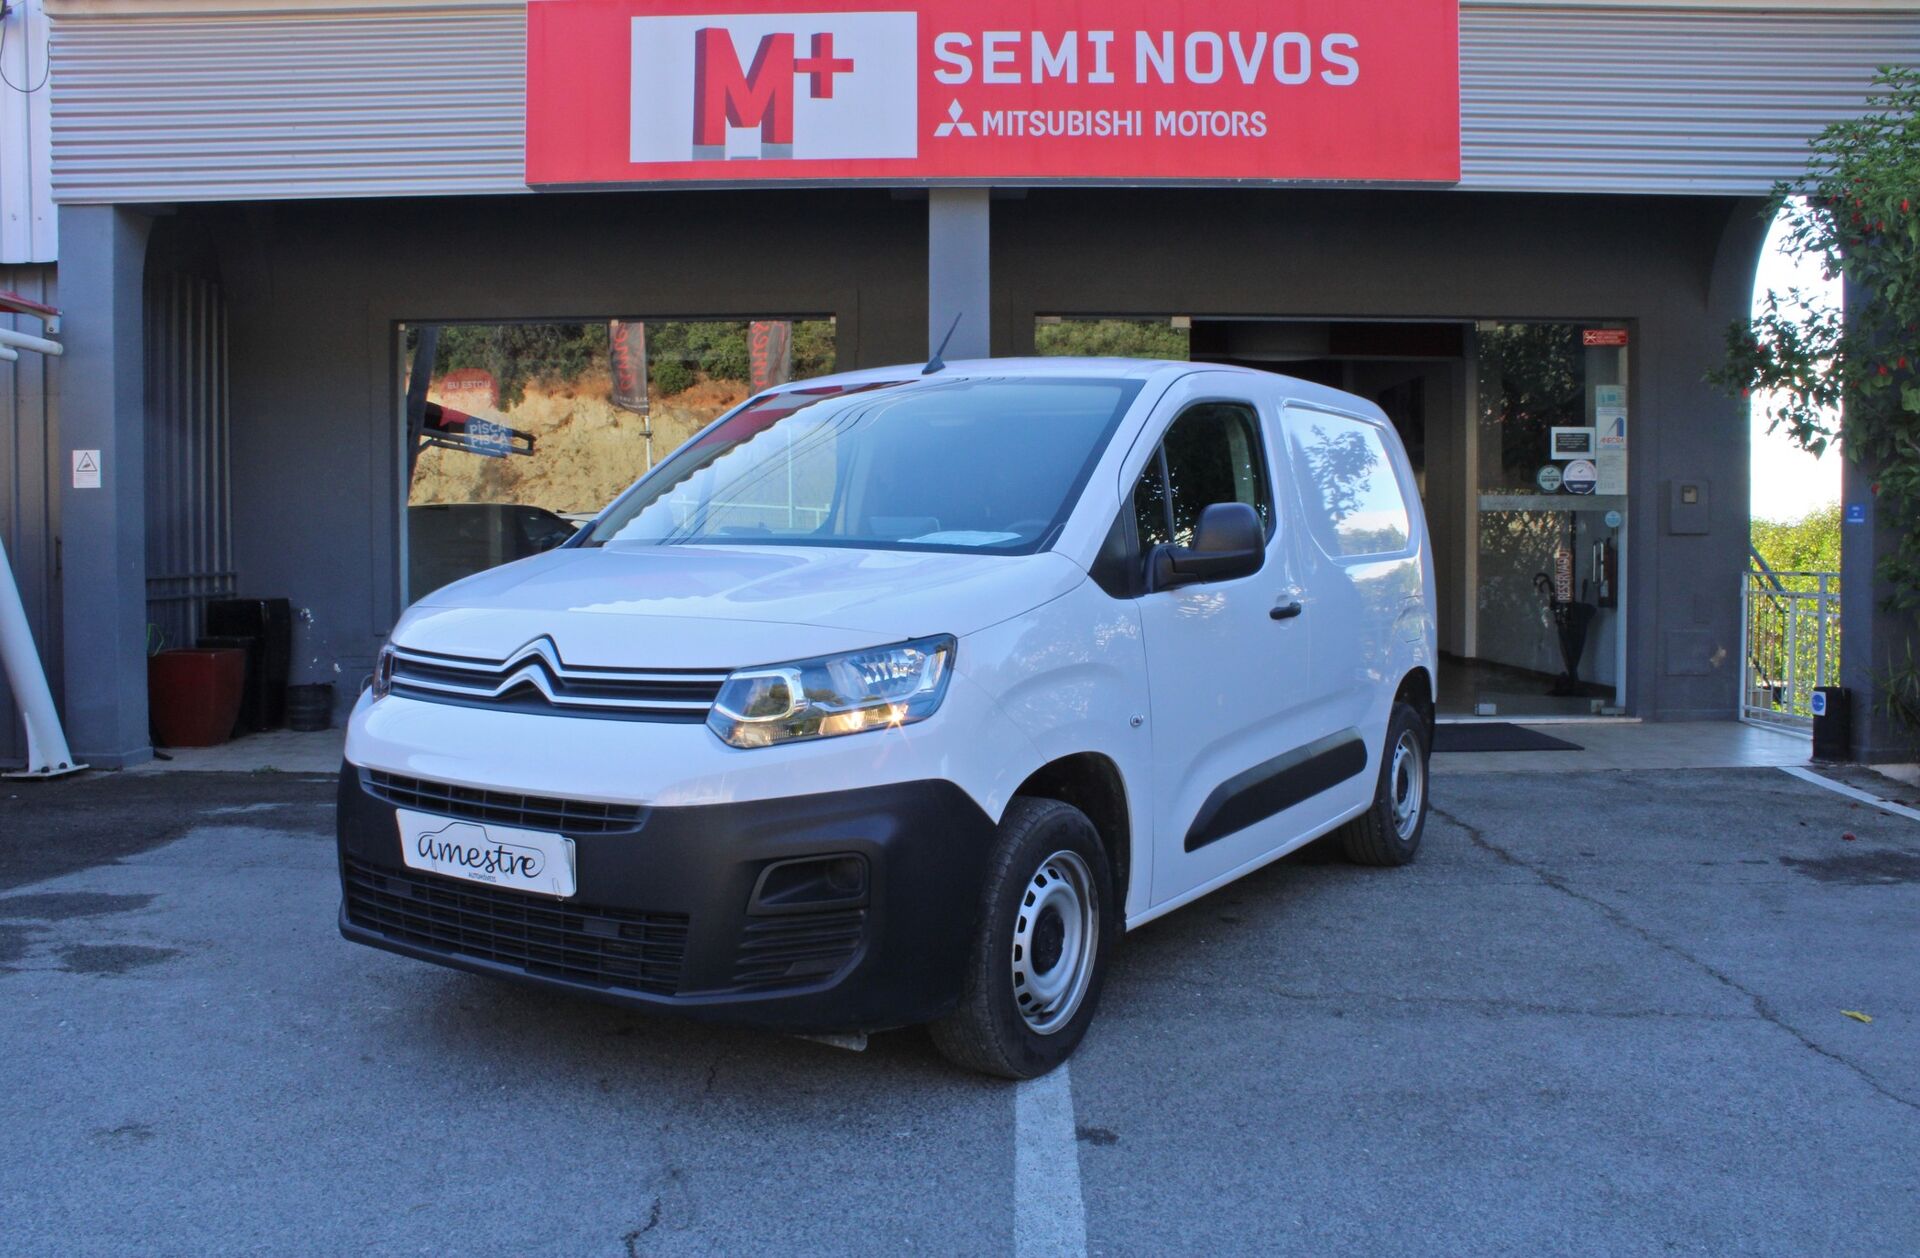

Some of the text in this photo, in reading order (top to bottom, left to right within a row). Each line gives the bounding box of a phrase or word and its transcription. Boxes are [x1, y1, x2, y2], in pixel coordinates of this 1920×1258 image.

[933, 30, 1360, 86] SEMI NOVOS
[982, 110, 1267, 137] MITSUBISHI MOTORS
[418, 834, 536, 878] amestre
